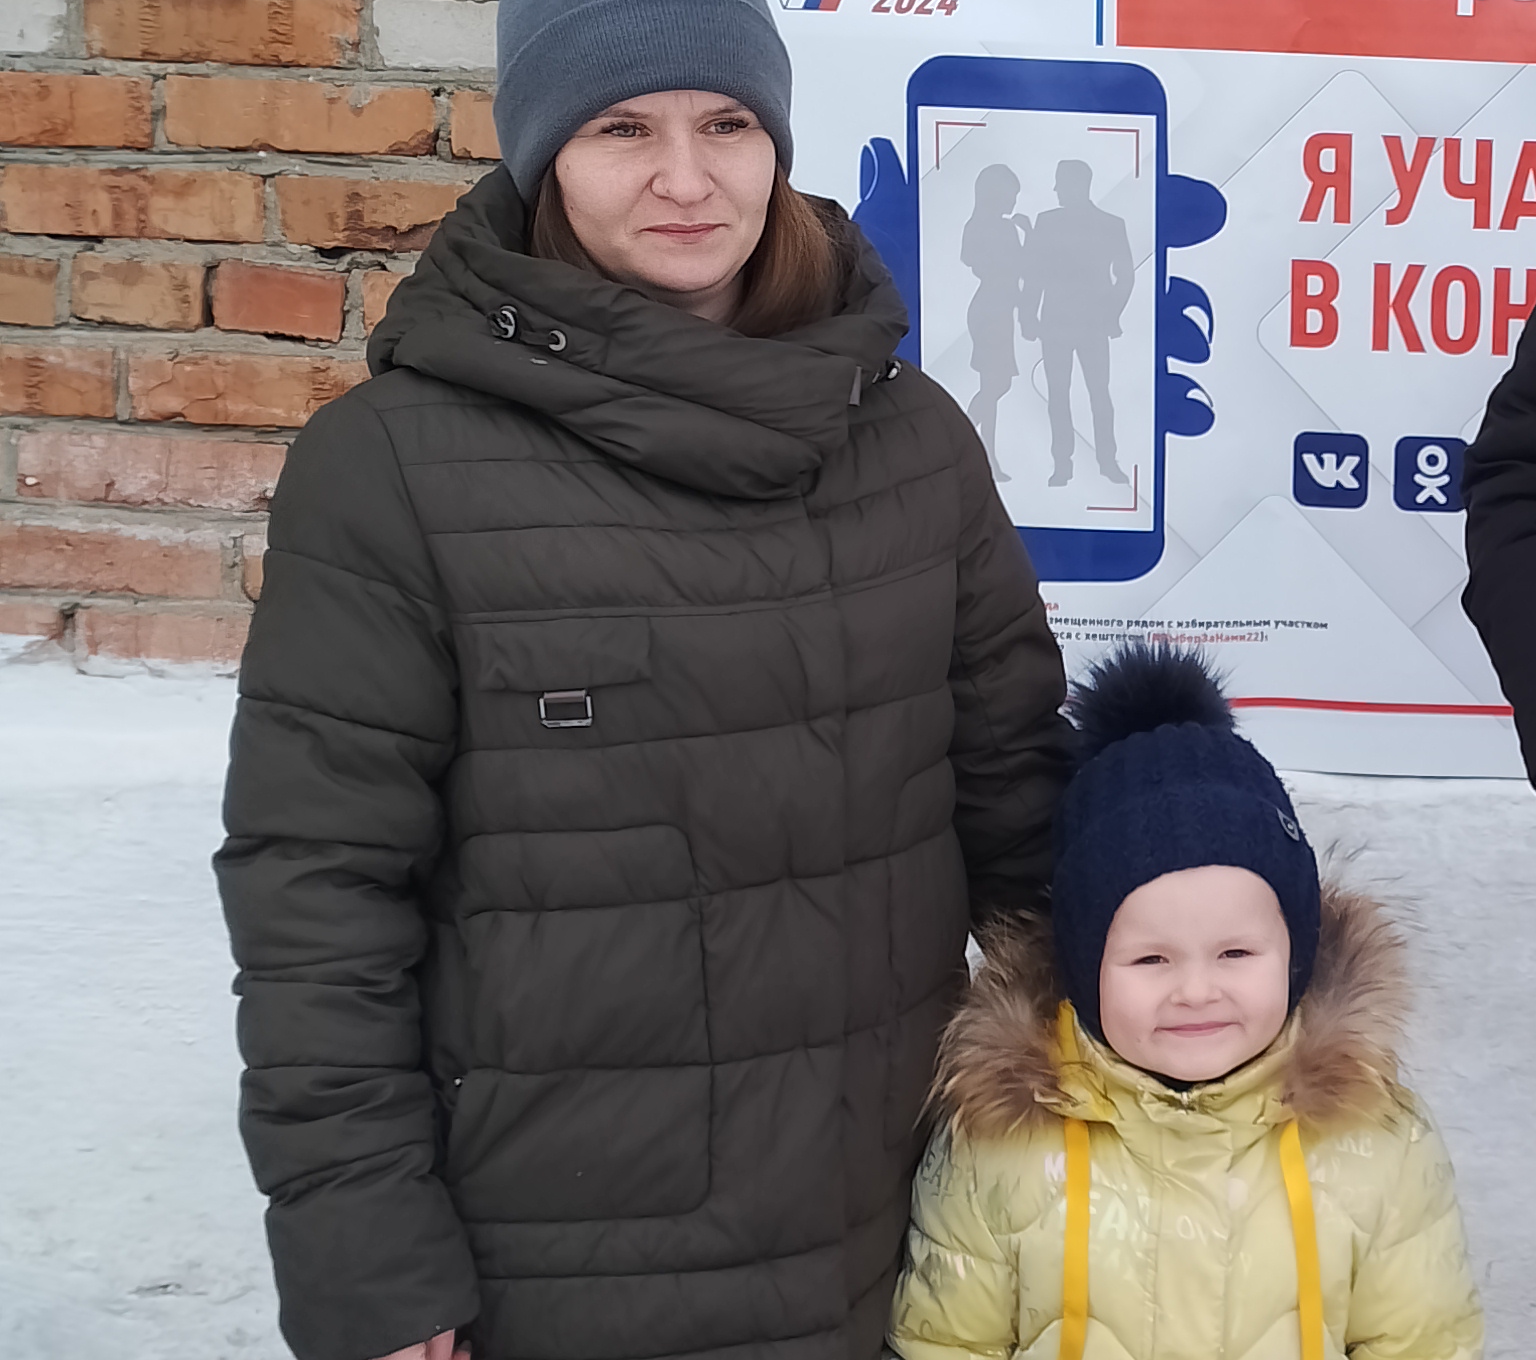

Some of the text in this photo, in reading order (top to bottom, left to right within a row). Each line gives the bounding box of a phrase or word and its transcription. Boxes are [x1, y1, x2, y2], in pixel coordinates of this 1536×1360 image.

[1298, 131, 1354, 225] Я
[1289, 257, 1340, 349] В
[1126, 619, 1164, 630] рядом
[1167, 621, 1174, 629] с
[1176, 618, 1271, 630] избирательным
[1273, 619, 1329, 630] участком
